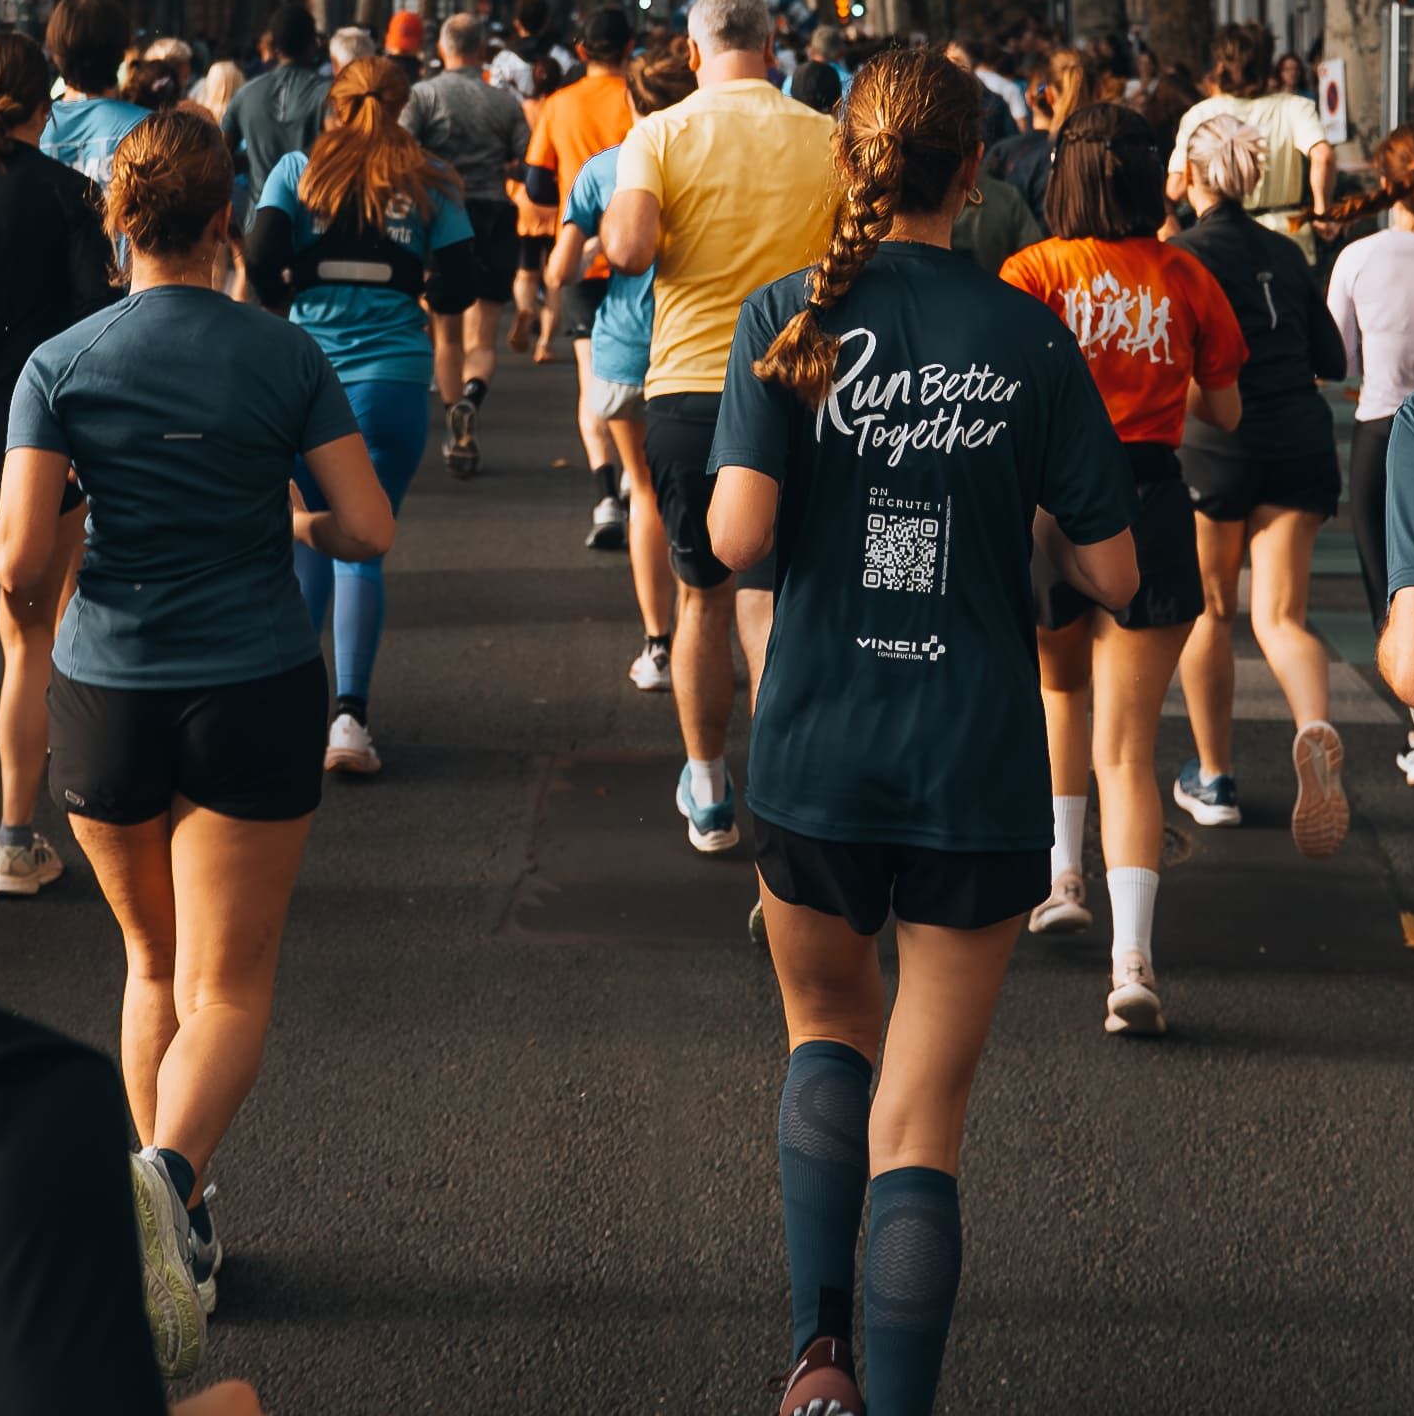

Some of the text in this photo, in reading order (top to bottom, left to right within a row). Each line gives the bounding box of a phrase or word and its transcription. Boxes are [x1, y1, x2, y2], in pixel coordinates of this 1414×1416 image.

[815, 327, 1022, 444] Run Better
[852, 402, 1007, 468] Together
[869, 487, 888, 496] ON
[869, 496, 931, 511] RECRUTE
[856, 637, 917, 653] VINCI
